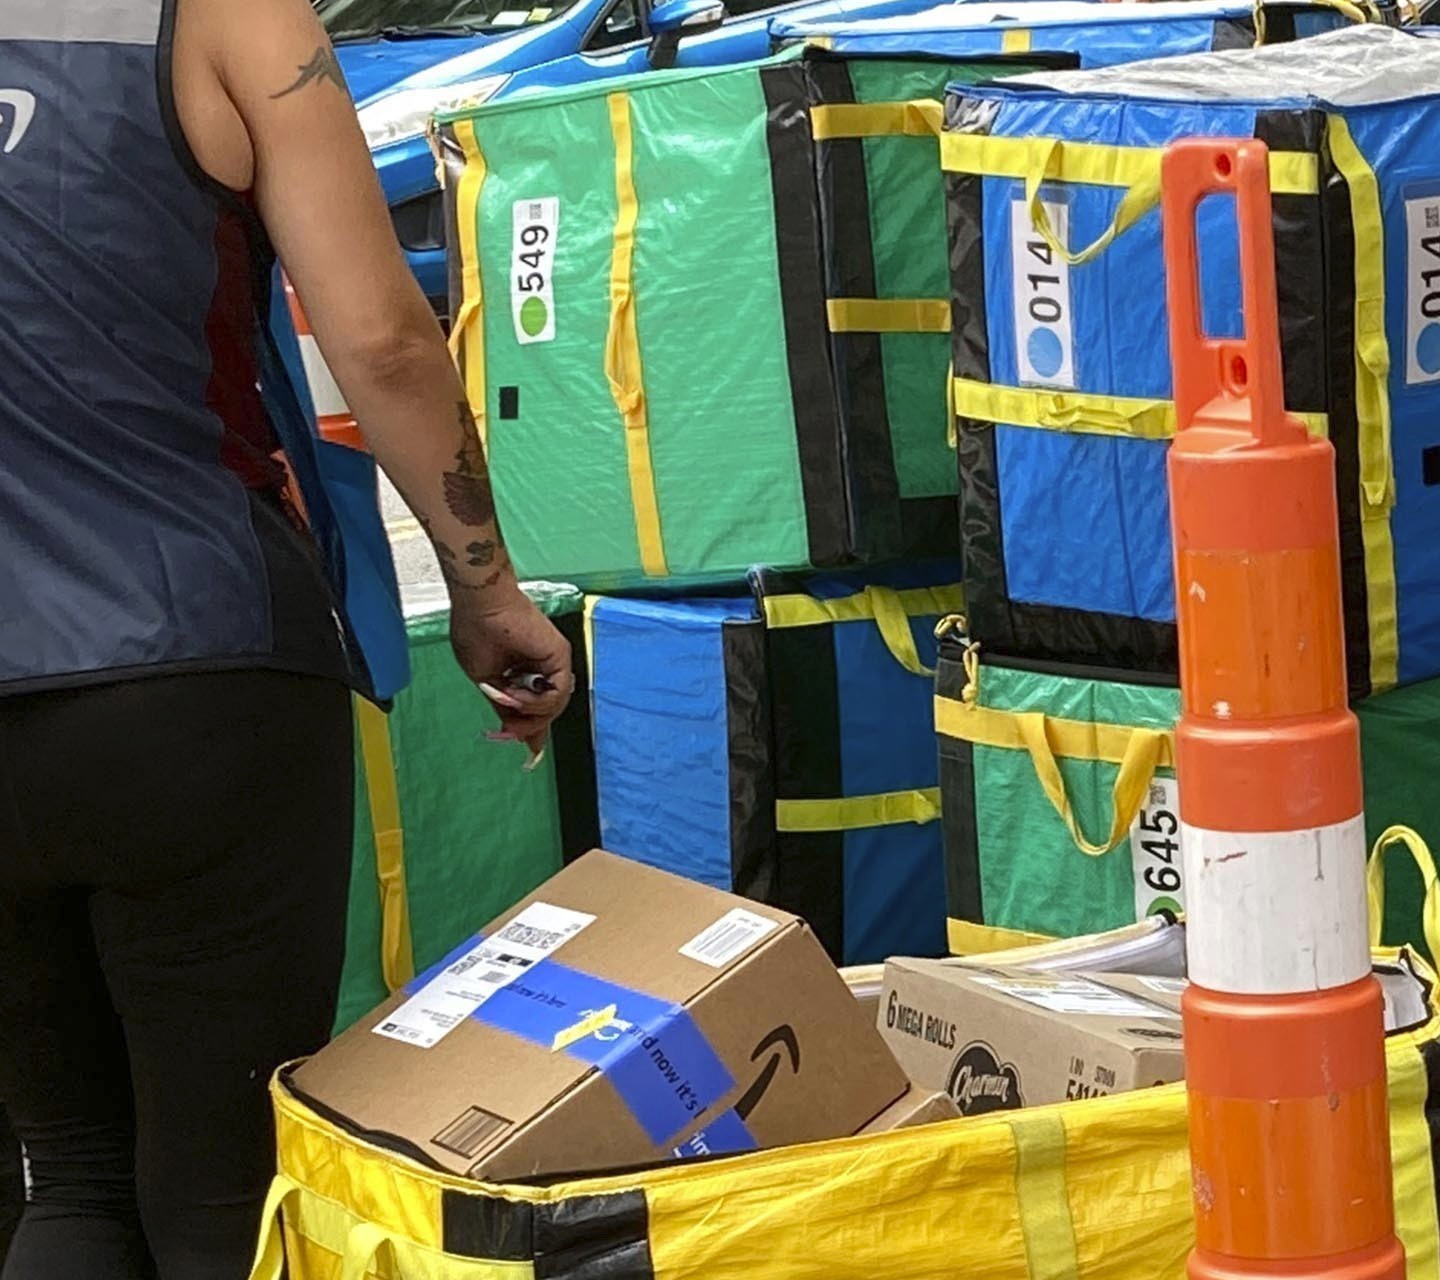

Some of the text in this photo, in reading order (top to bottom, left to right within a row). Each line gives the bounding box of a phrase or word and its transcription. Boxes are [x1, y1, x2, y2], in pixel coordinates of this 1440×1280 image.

[517, 224, 549, 292] 549
[1026, 239, 1061, 323] 014
[1139, 808, 1181, 893] 645
[886, 989, 957, 1050] 6 MEGA ROLLS
[650, 1046, 681, 1084] now
[675, 1079, 699, 1112] it's
[951, 1063, 1011, 1106] Charmin
